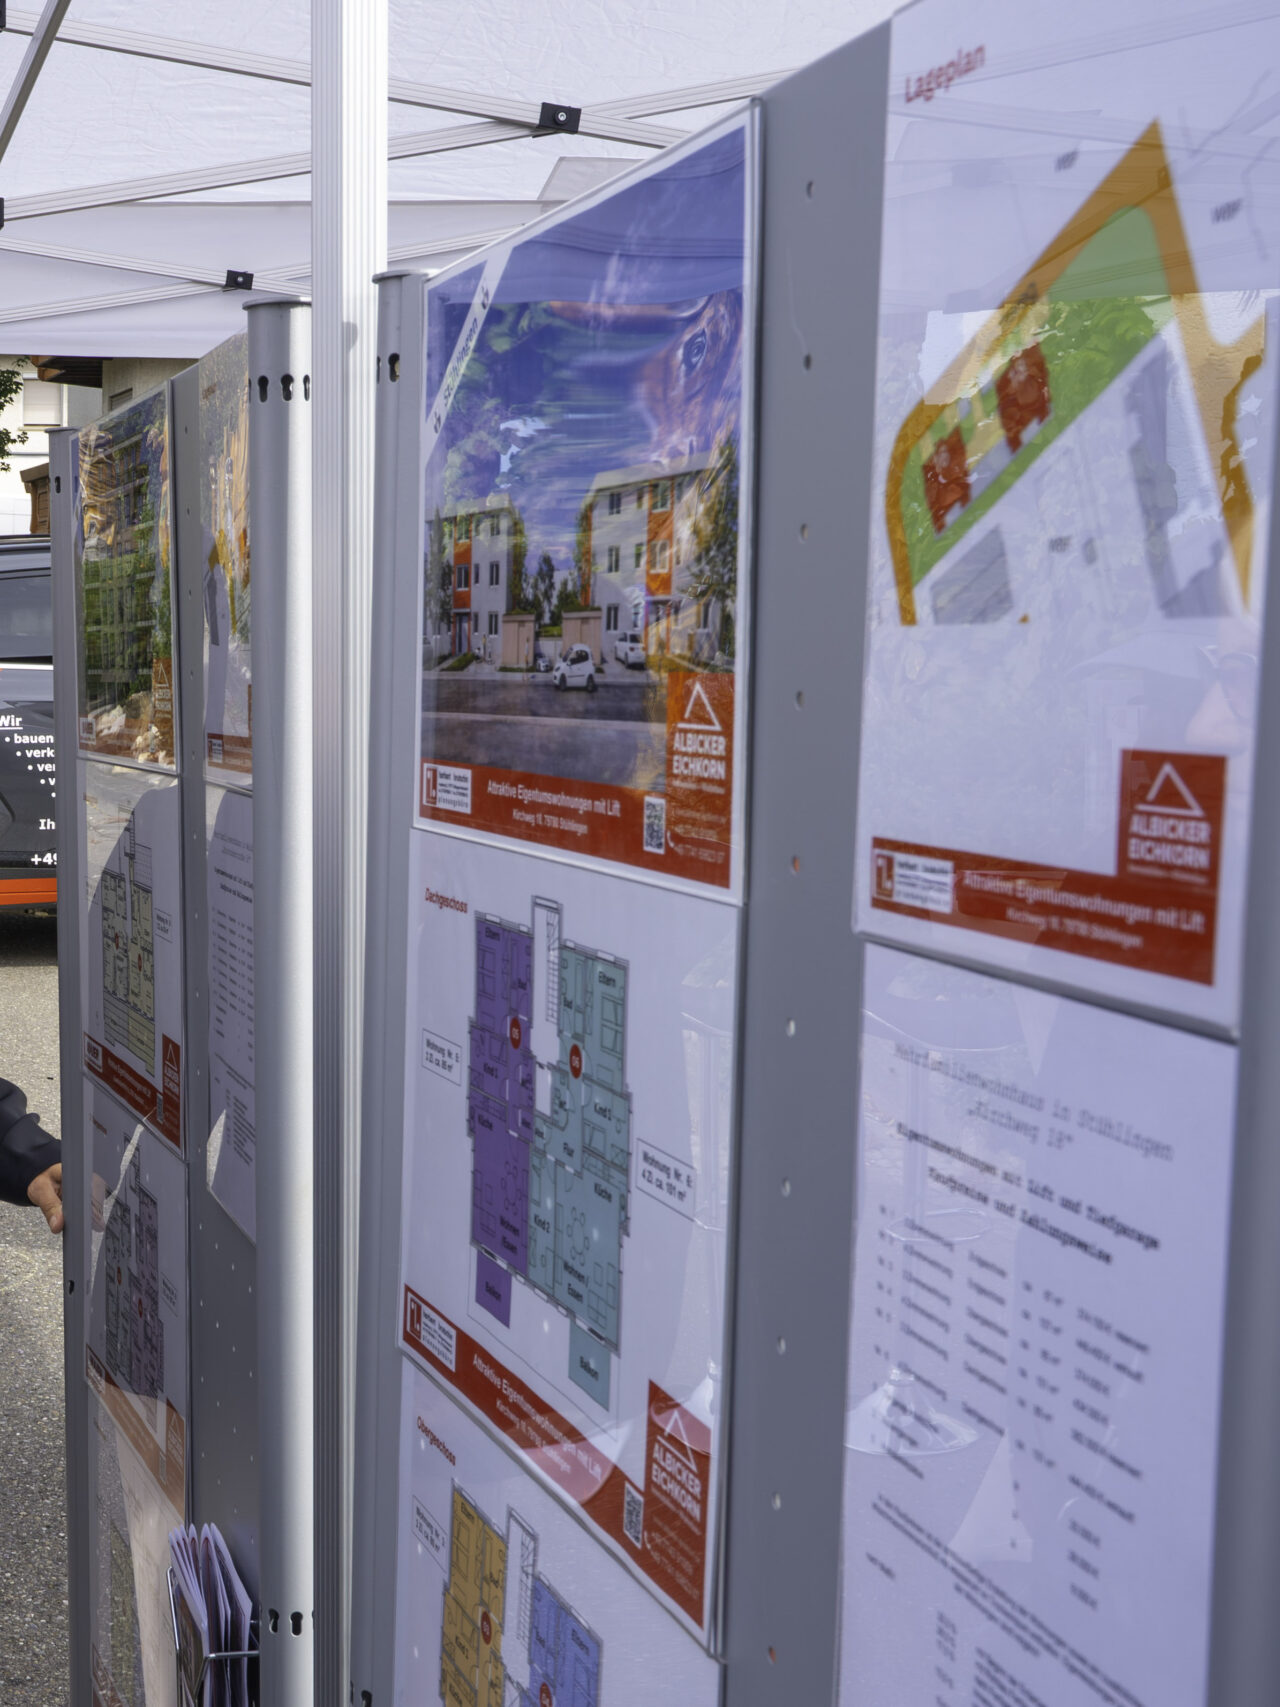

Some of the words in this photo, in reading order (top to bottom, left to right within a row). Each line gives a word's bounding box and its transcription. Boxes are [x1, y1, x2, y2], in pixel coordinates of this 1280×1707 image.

[904, 44, 985, 103] Lageplan
[14, 733, 55, 744] bauen
[673, 731, 726, 757] ALBICKER
[25, 747, 55, 758] verk
[672, 755, 726, 780] EICHKORN
[487, 779, 517, 799] Attraktive
[517, 784, 593, 815] Eigentumswohnungen
[593, 798, 606, 816] mit
[607, 799, 621, 818] Lift
[39, 818, 56, 830] Ih
[1129, 814, 1211, 844] ALBICKER
[1128, 838, 1210, 869] EICHKORN
[962, 872, 1014, 898] Attraktive
[424, 887, 468, 914] Dachgeschoss
[598, 970, 616, 988] Eltern
[642, 1150, 671, 1180] Wohnung
[594, 1182, 612, 1203] Küche
[568, 1283, 583, 1303] Essen
[473, 1354, 502, 1390] Attraktive
[417, 1415, 456, 1466] Obergeschoss
[653, 1442, 701, 1500] ALBICKER
[651, 1461, 701, 1523] EICHKORN
